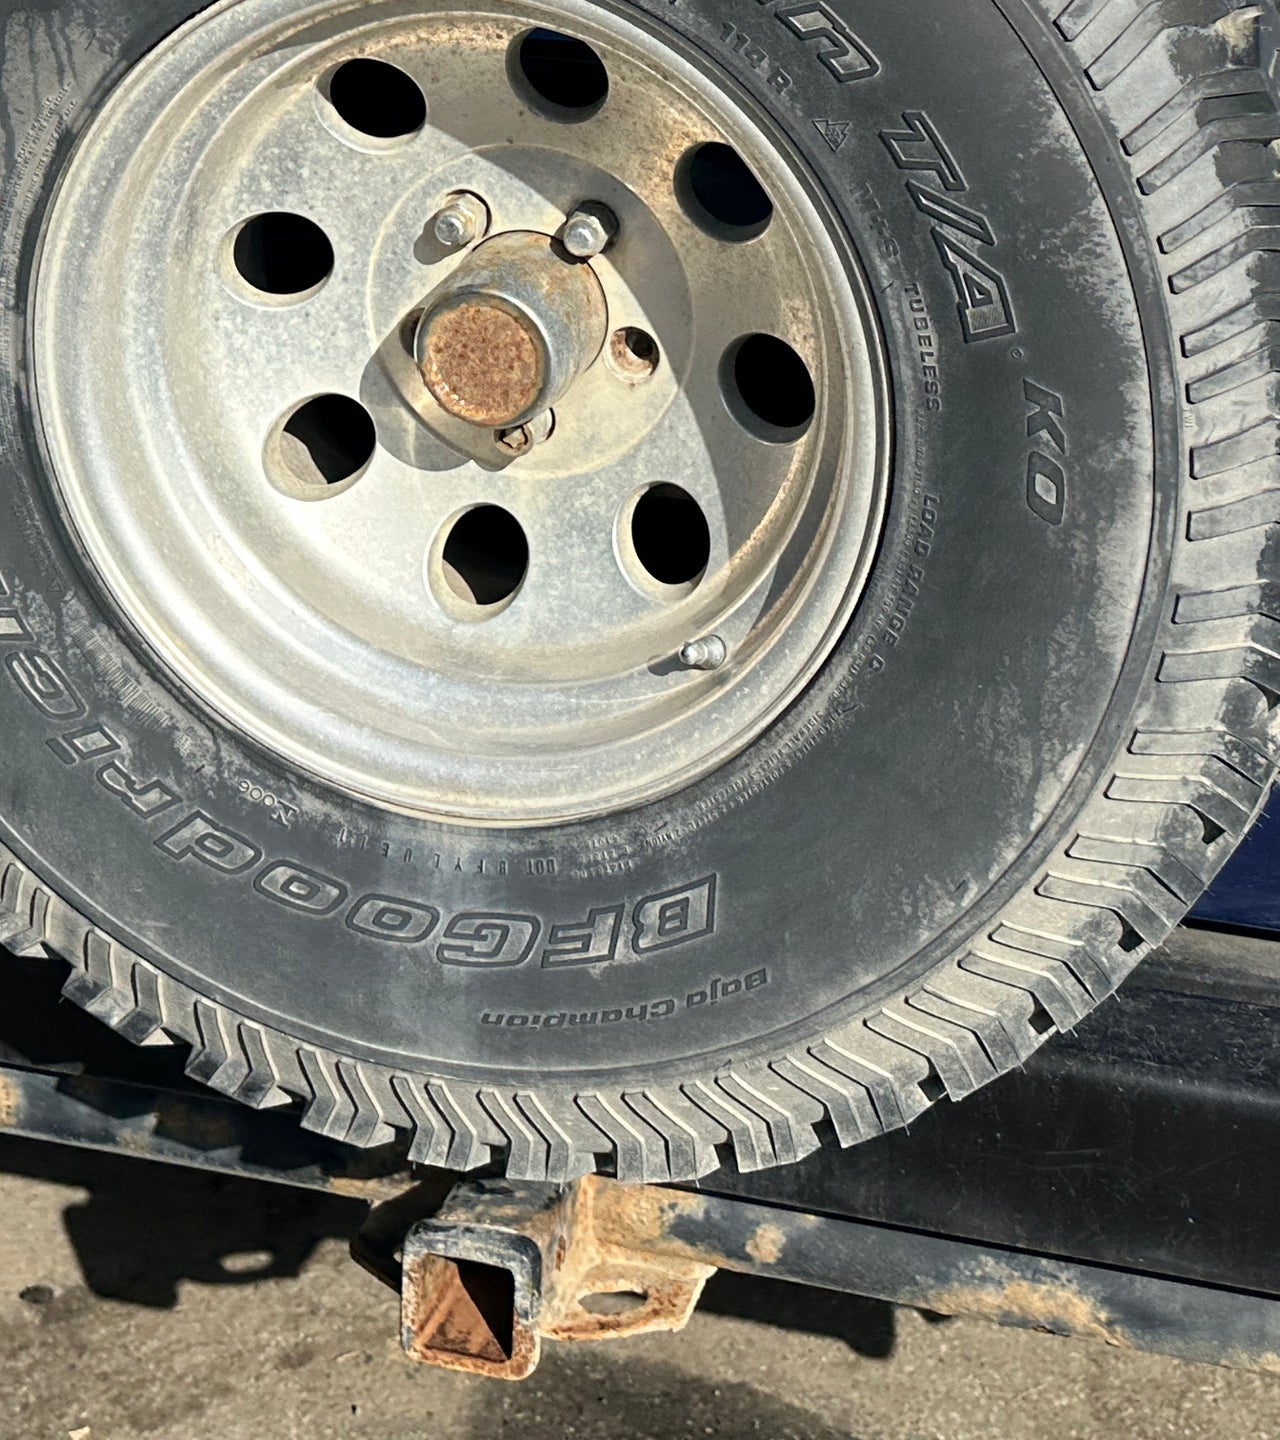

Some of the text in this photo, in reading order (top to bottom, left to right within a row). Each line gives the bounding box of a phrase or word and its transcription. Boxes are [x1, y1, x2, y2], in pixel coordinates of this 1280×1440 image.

[877, 108, 1015, 344] T/A
[1023, 378, 1066, 527] KO
[903, 281, 940, 412] TUBELESS
[912, 494, 940, 558] LOAD
[879, 563, 925, 649] RANGE
[524, 857, 557, 874] DOT
[478, 966, 770, 1030] Baja Champion
